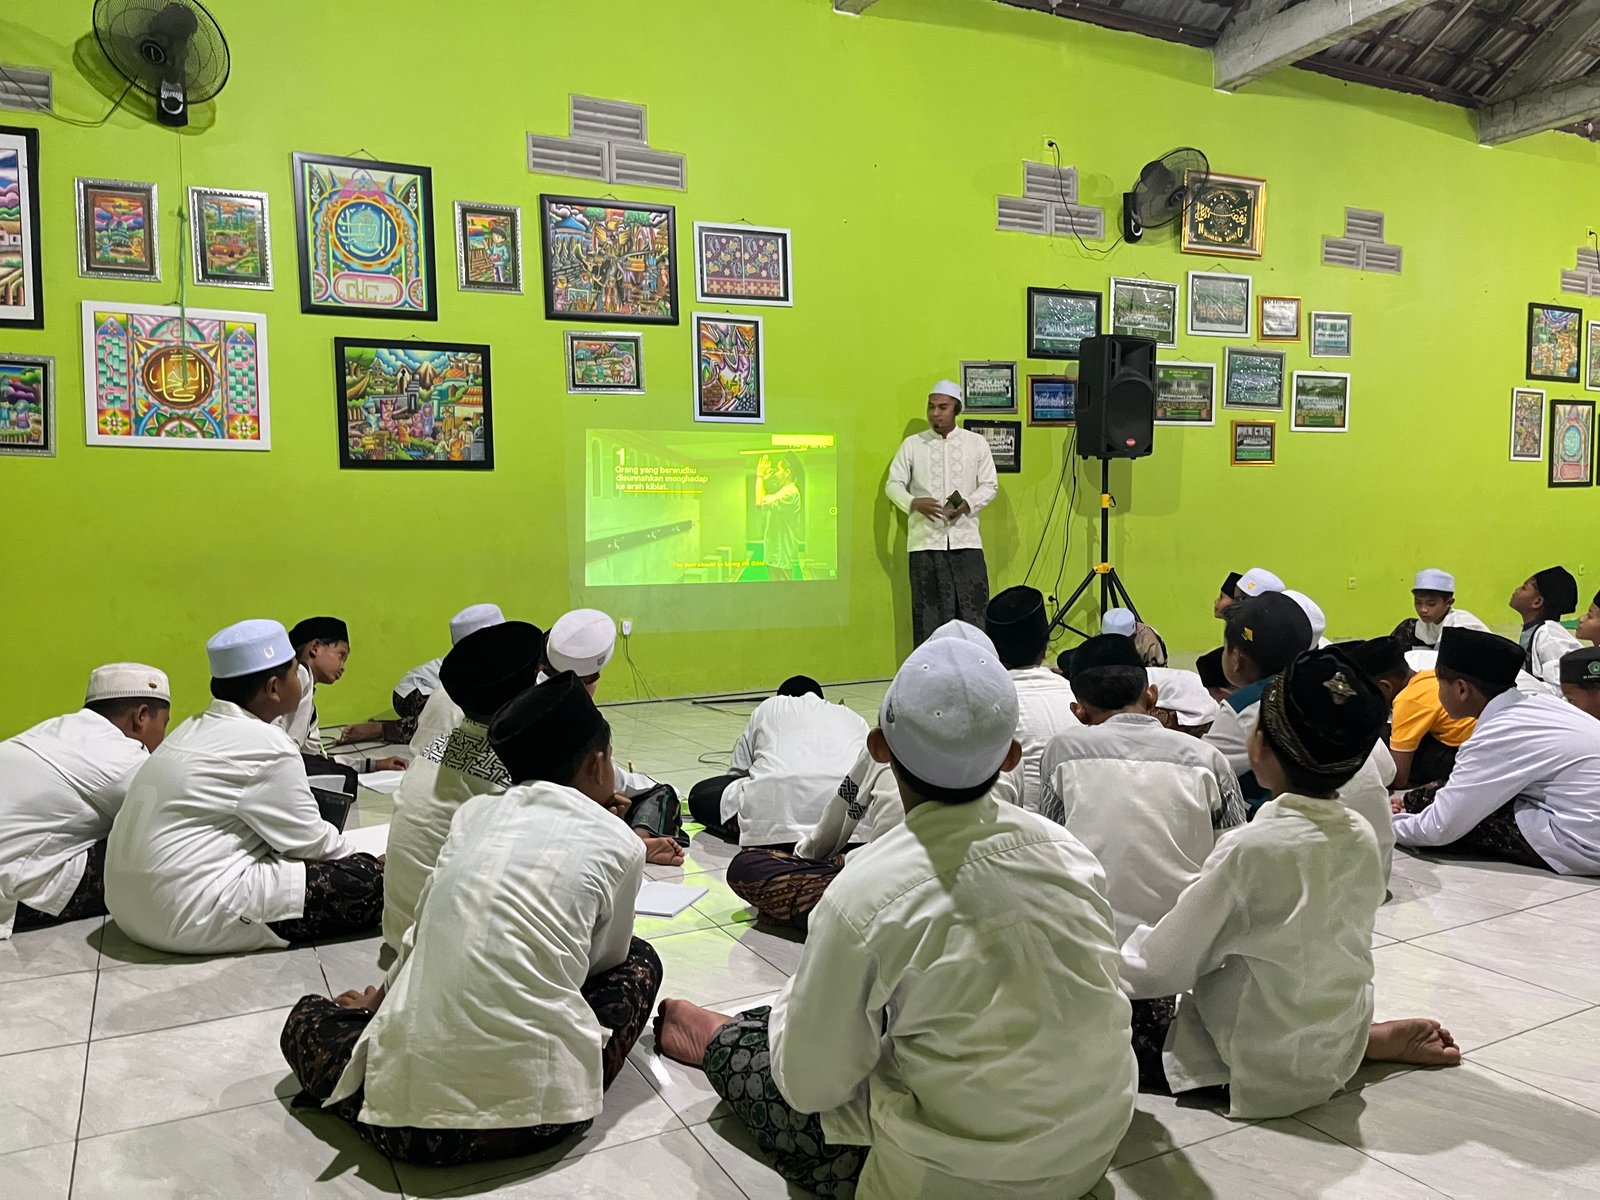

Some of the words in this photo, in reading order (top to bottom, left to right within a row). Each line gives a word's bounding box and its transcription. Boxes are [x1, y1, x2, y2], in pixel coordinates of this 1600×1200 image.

[1198, 223, 1204, 235] N
[1237, 227, 1244, 238] U
[616, 448, 625, 466] 1
[615, 466, 639, 475] Orang
[640, 467, 658, 475] yang
[660, 466, 697, 474] berwudhu
[615, 474, 664, 482] disunnahkan
[665, 475, 708, 483] menghadap
